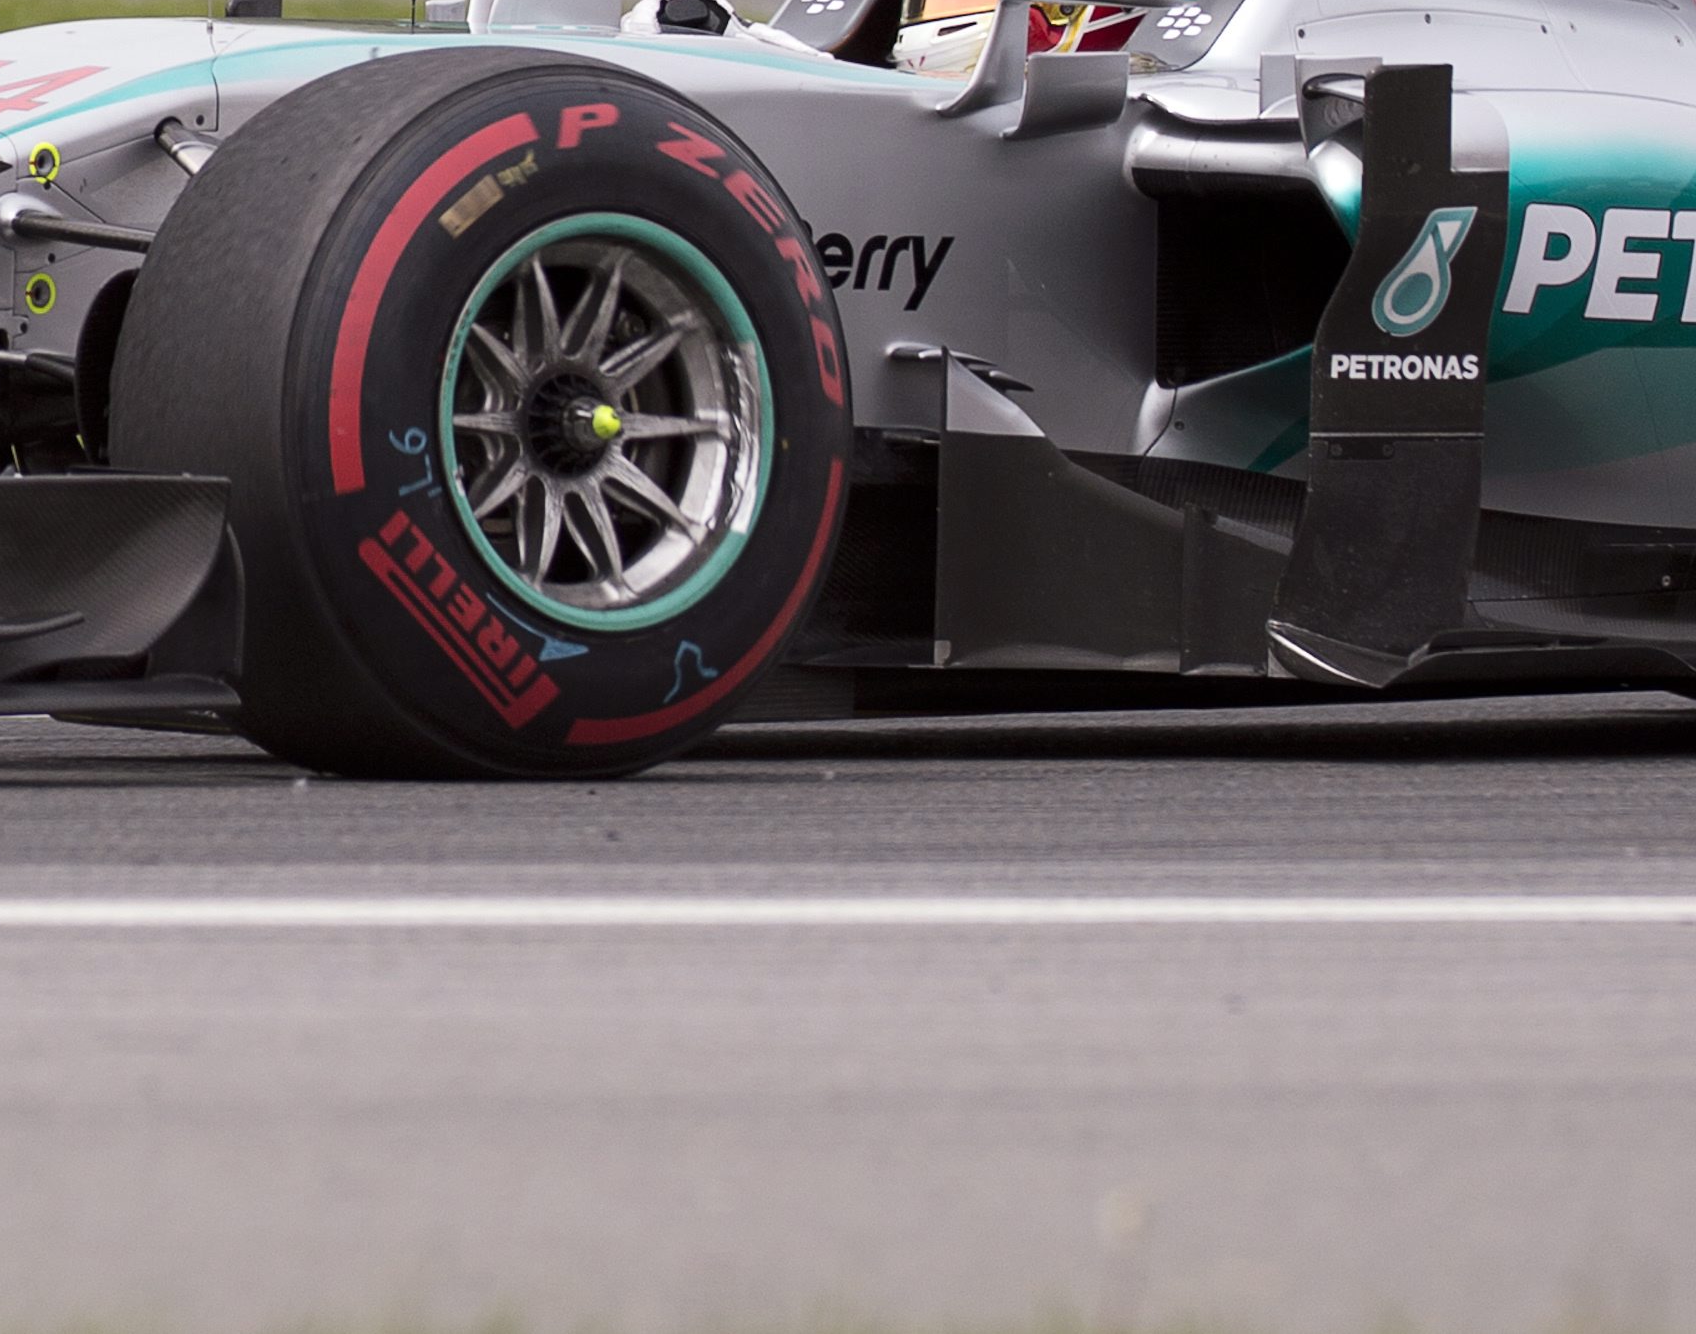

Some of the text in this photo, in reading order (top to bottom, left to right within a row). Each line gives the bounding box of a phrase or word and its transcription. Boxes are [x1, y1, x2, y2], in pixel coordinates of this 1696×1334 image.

[655, 121, 845, 410] ZERO
[800, 219, 956, 312] erry
[1330, 353, 1480, 381] PETRONAS
[358, 509, 562, 731] PIRELLI
